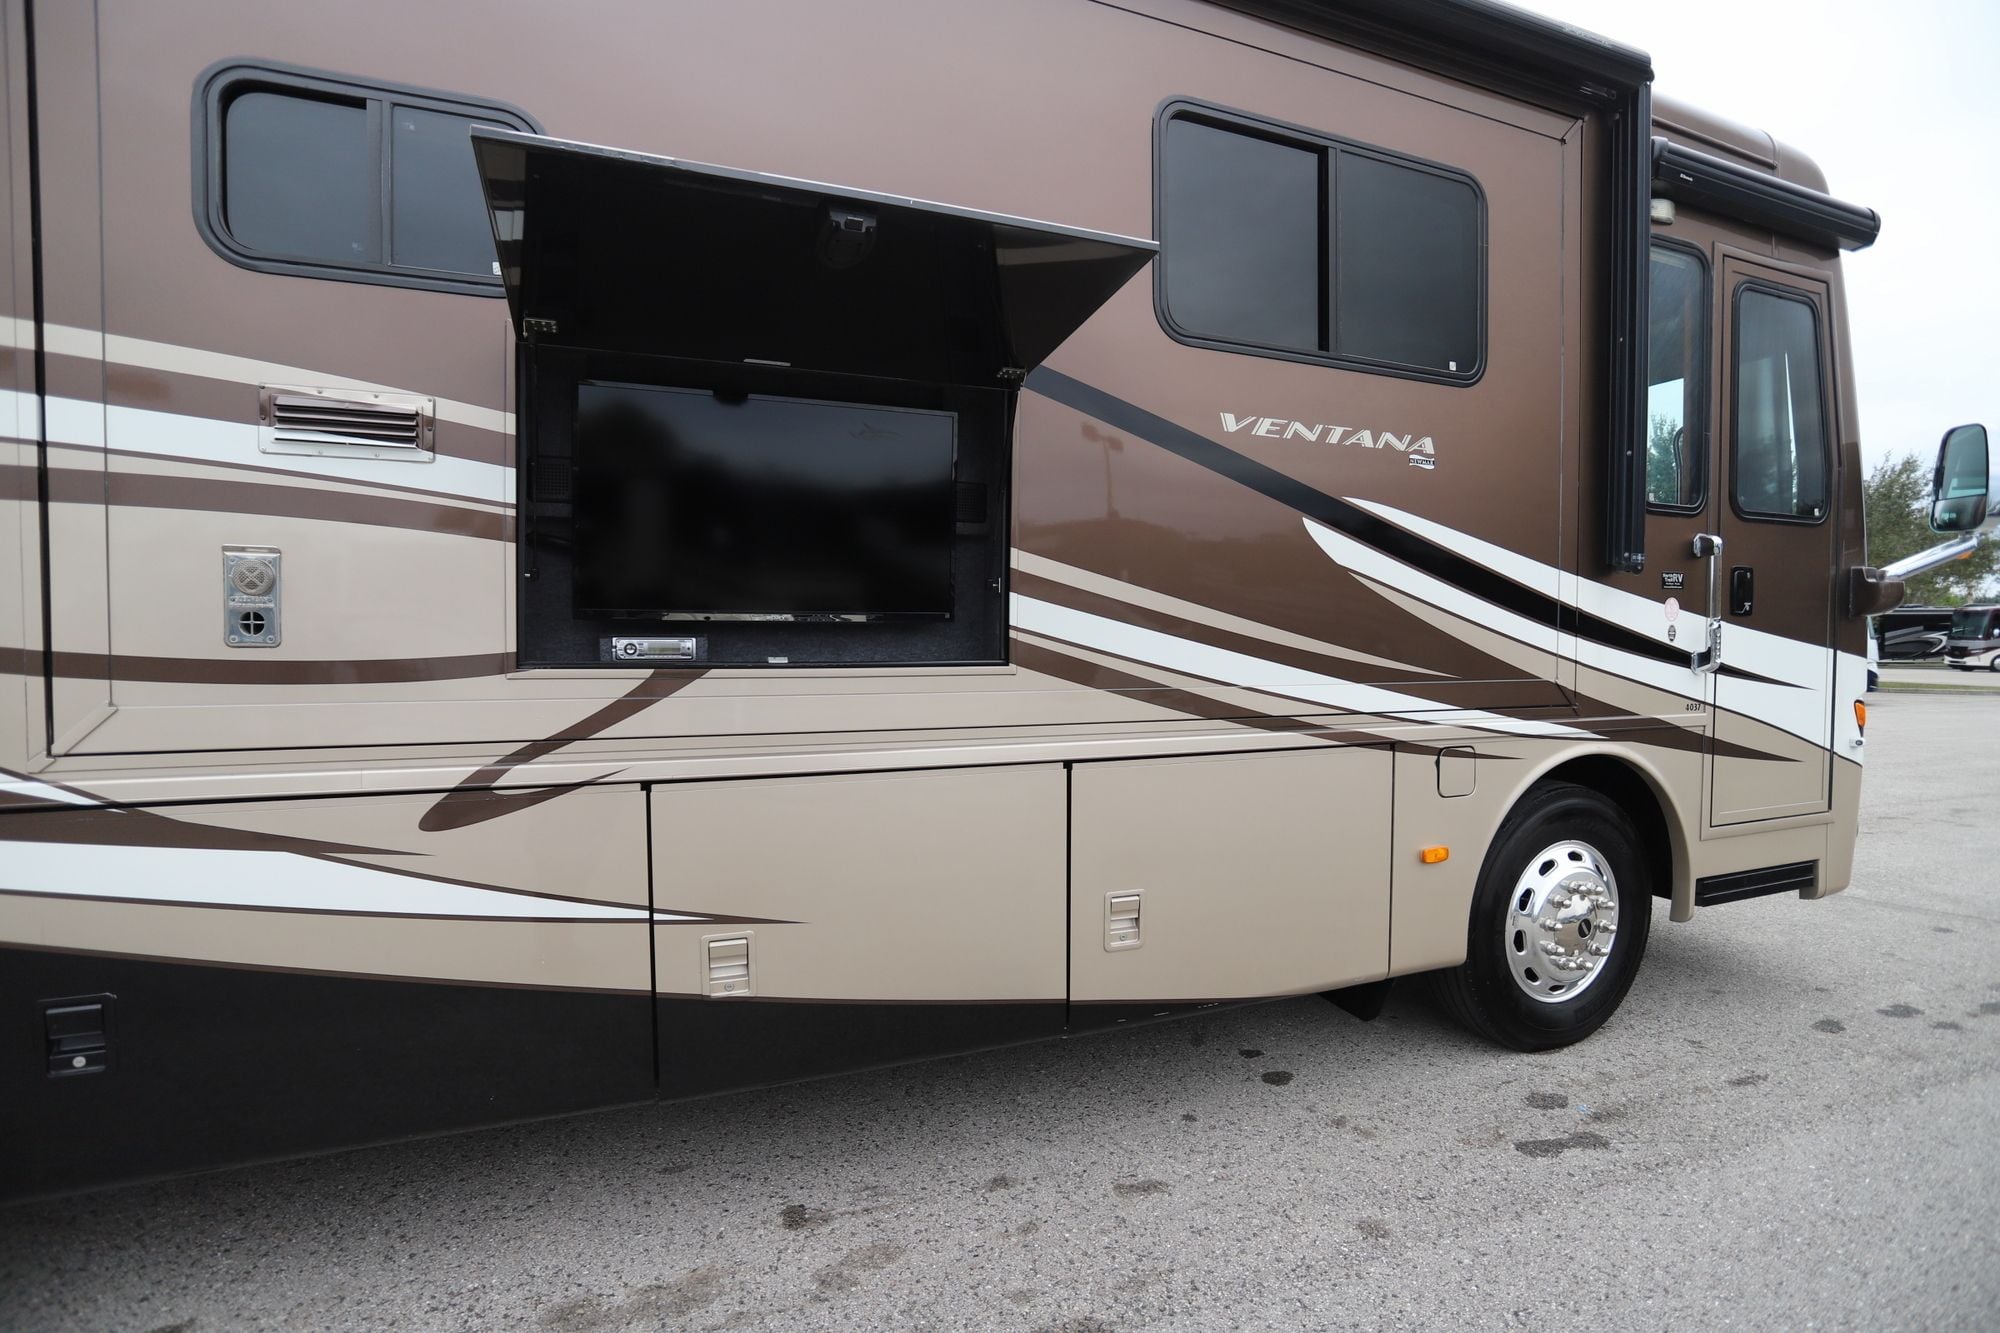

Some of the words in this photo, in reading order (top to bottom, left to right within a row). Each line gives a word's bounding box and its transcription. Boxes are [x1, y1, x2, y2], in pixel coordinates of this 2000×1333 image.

[1220, 412, 1435, 454] VENTANA
[1673, 573, 1684, 583] RV
[1685, 703, 1701, 712] 4037
